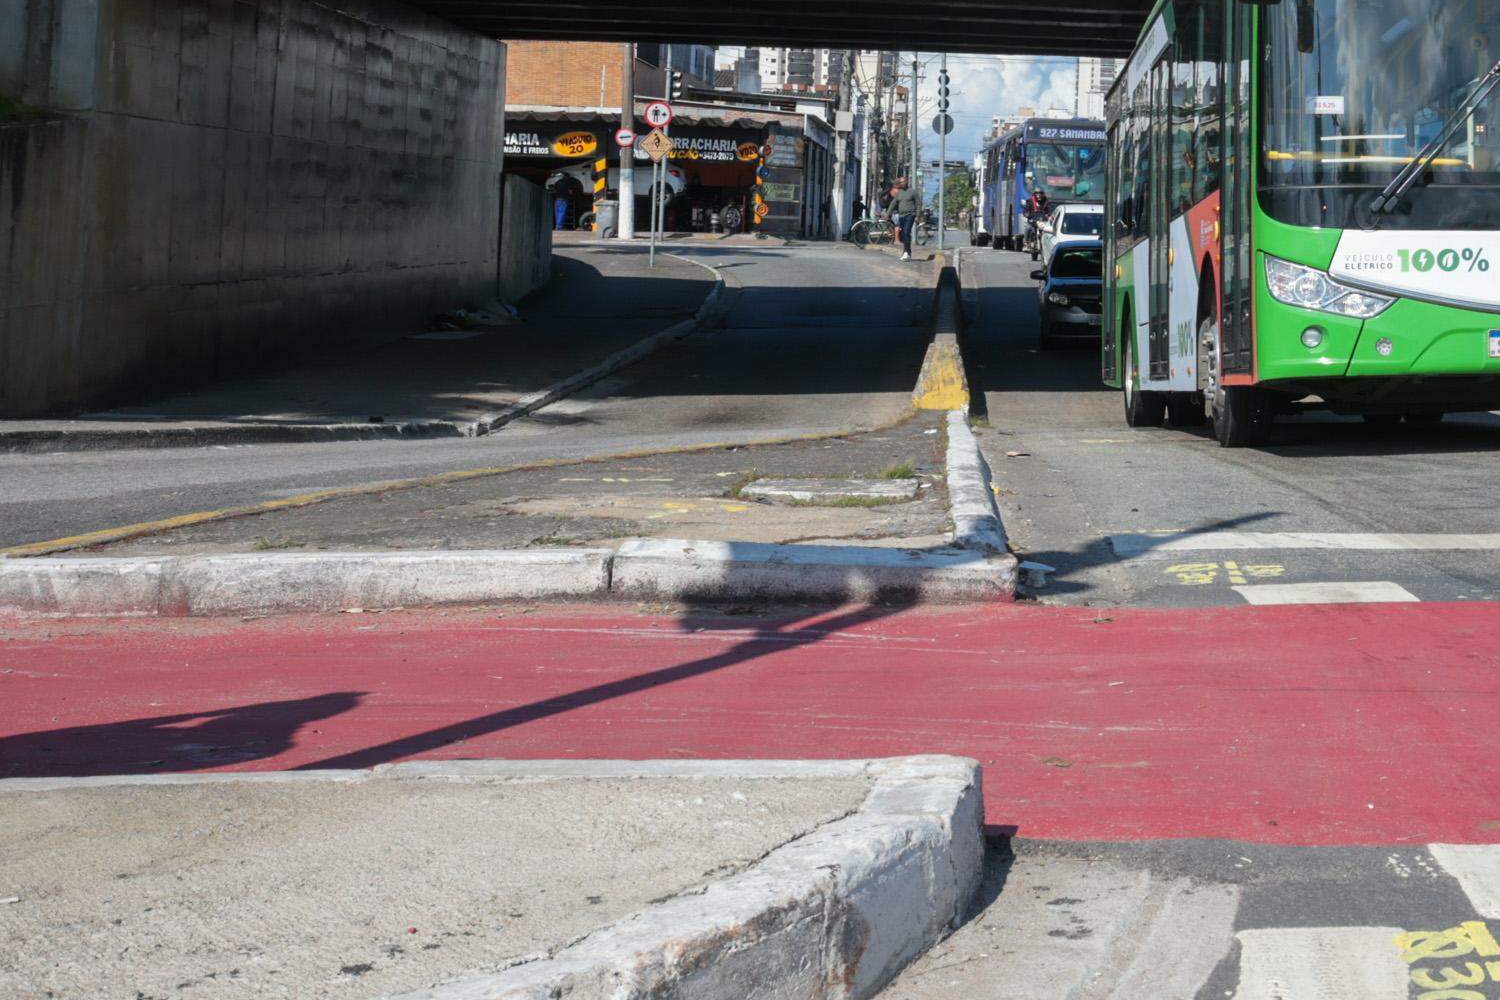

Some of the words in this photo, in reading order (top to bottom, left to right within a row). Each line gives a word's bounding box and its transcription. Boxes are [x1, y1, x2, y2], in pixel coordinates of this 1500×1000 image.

[1040, 128, 1057, 138] 927
[528, 146, 549, 155] FREIOS
[569, 144, 584, 154] 20
[1397, 247, 1489, 273] 100%
